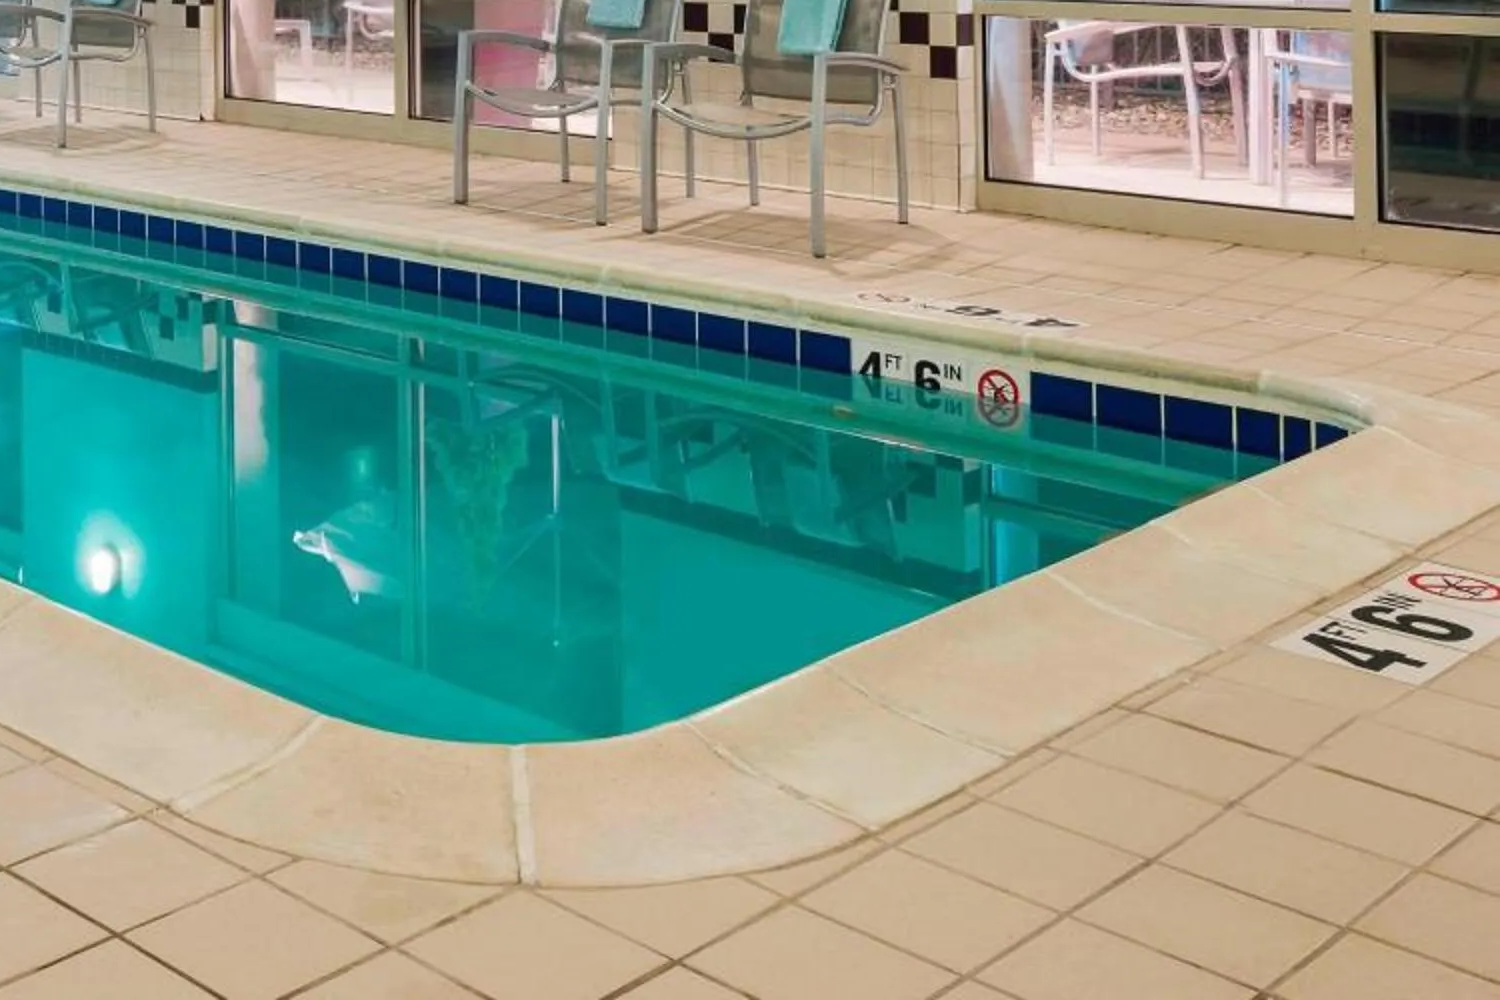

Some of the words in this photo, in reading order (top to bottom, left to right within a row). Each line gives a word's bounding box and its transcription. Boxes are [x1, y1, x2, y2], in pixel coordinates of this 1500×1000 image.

[859, 351, 881, 379] 4
[885, 353, 902, 370] FT
[915, 360, 941, 393] 6
[943, 363, 962, 381] IN
[1318, 620, 1368, 640] FT
[1351, 605, 1474, 642] 6
[1302, 633, 1428, 672] 4
